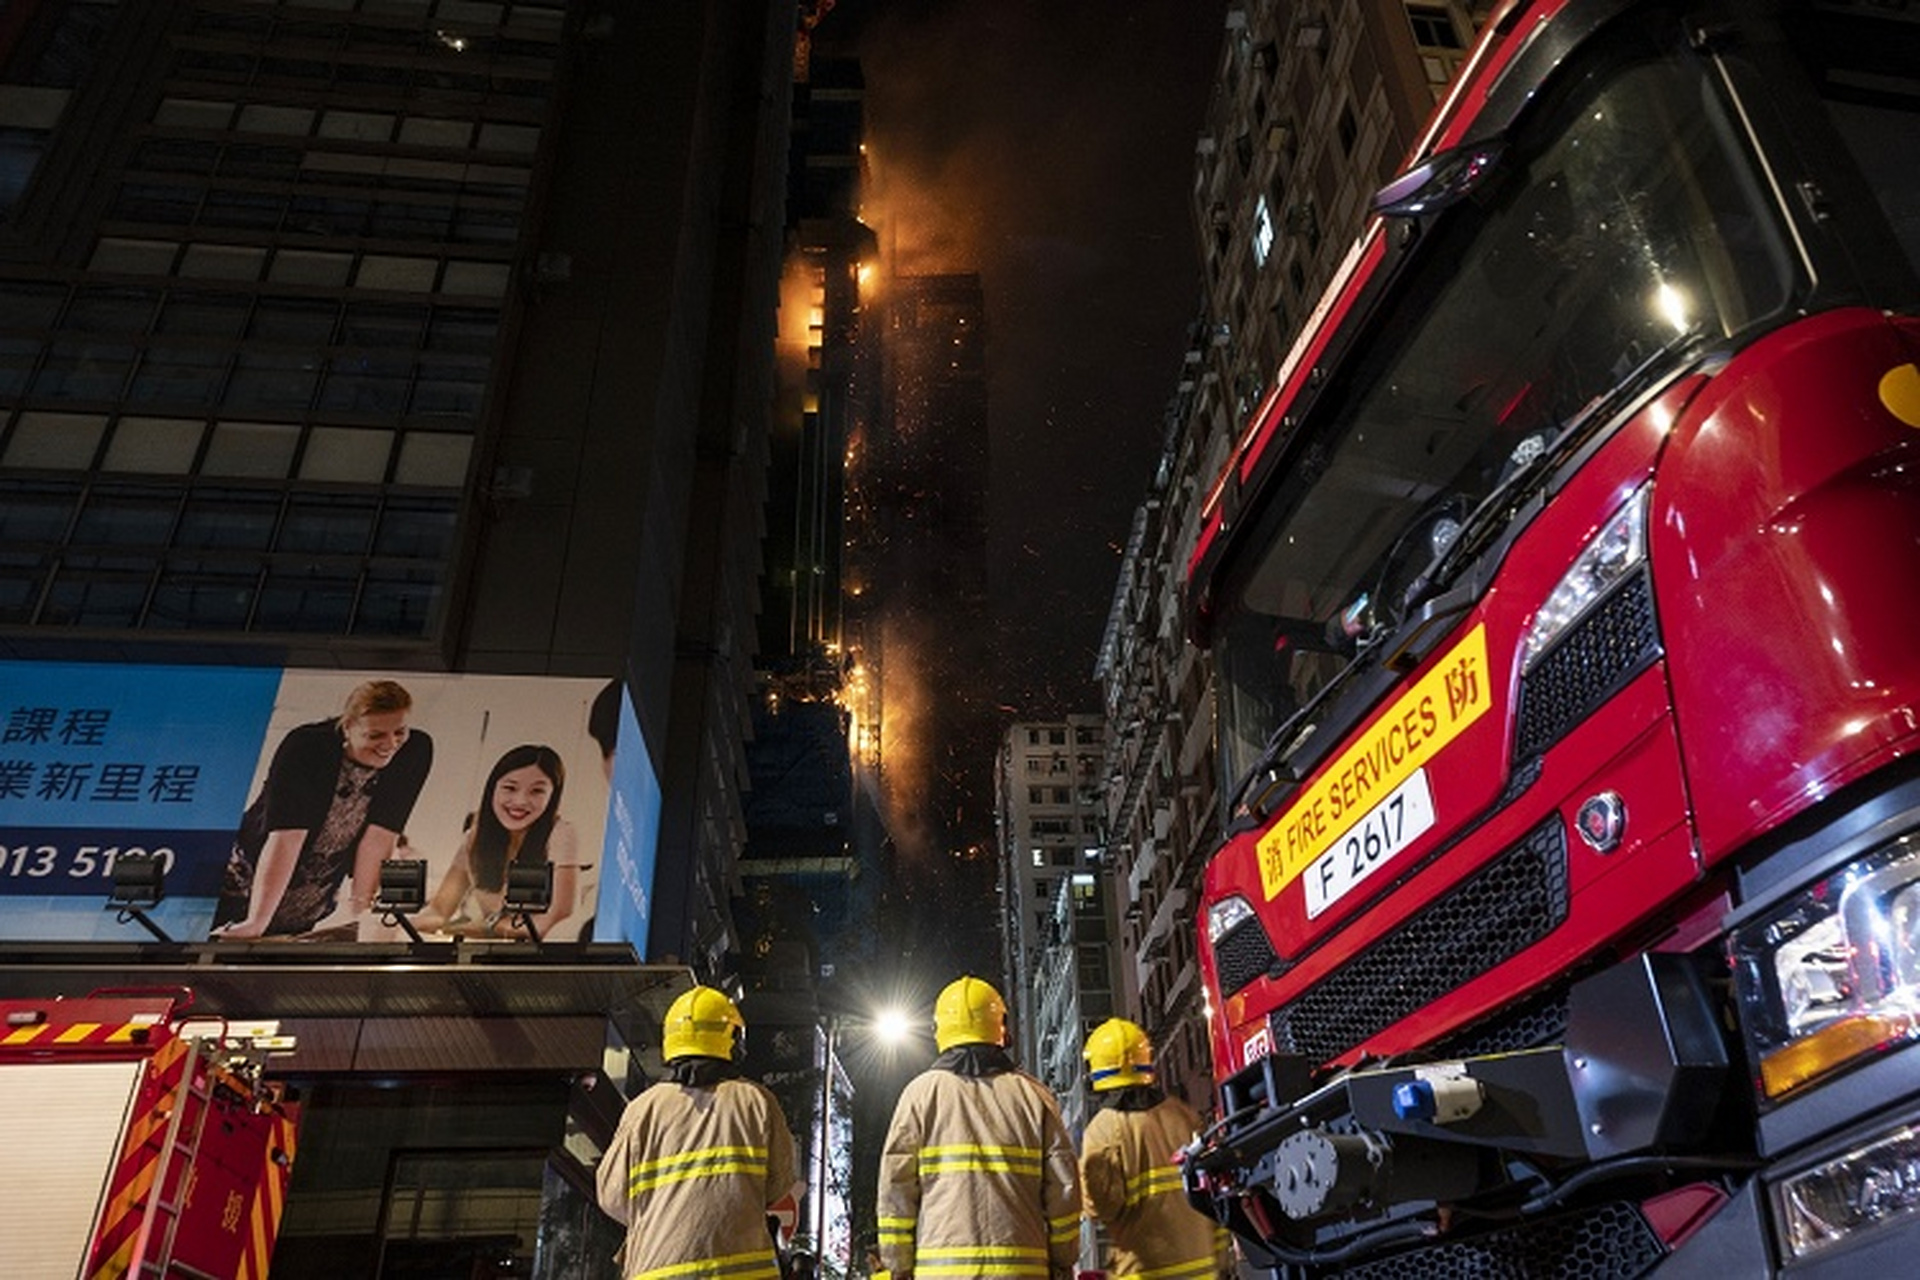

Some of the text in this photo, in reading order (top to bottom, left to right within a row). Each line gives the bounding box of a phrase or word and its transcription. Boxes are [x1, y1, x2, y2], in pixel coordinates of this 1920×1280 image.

[2, 706, 112, 746] 課程
[0, 760, 200, 803] 業新里程
[1266, 656, 1479, 886] 消 FIRE SERVICES 防
[1320, 793, 1405, 900] F 2617
